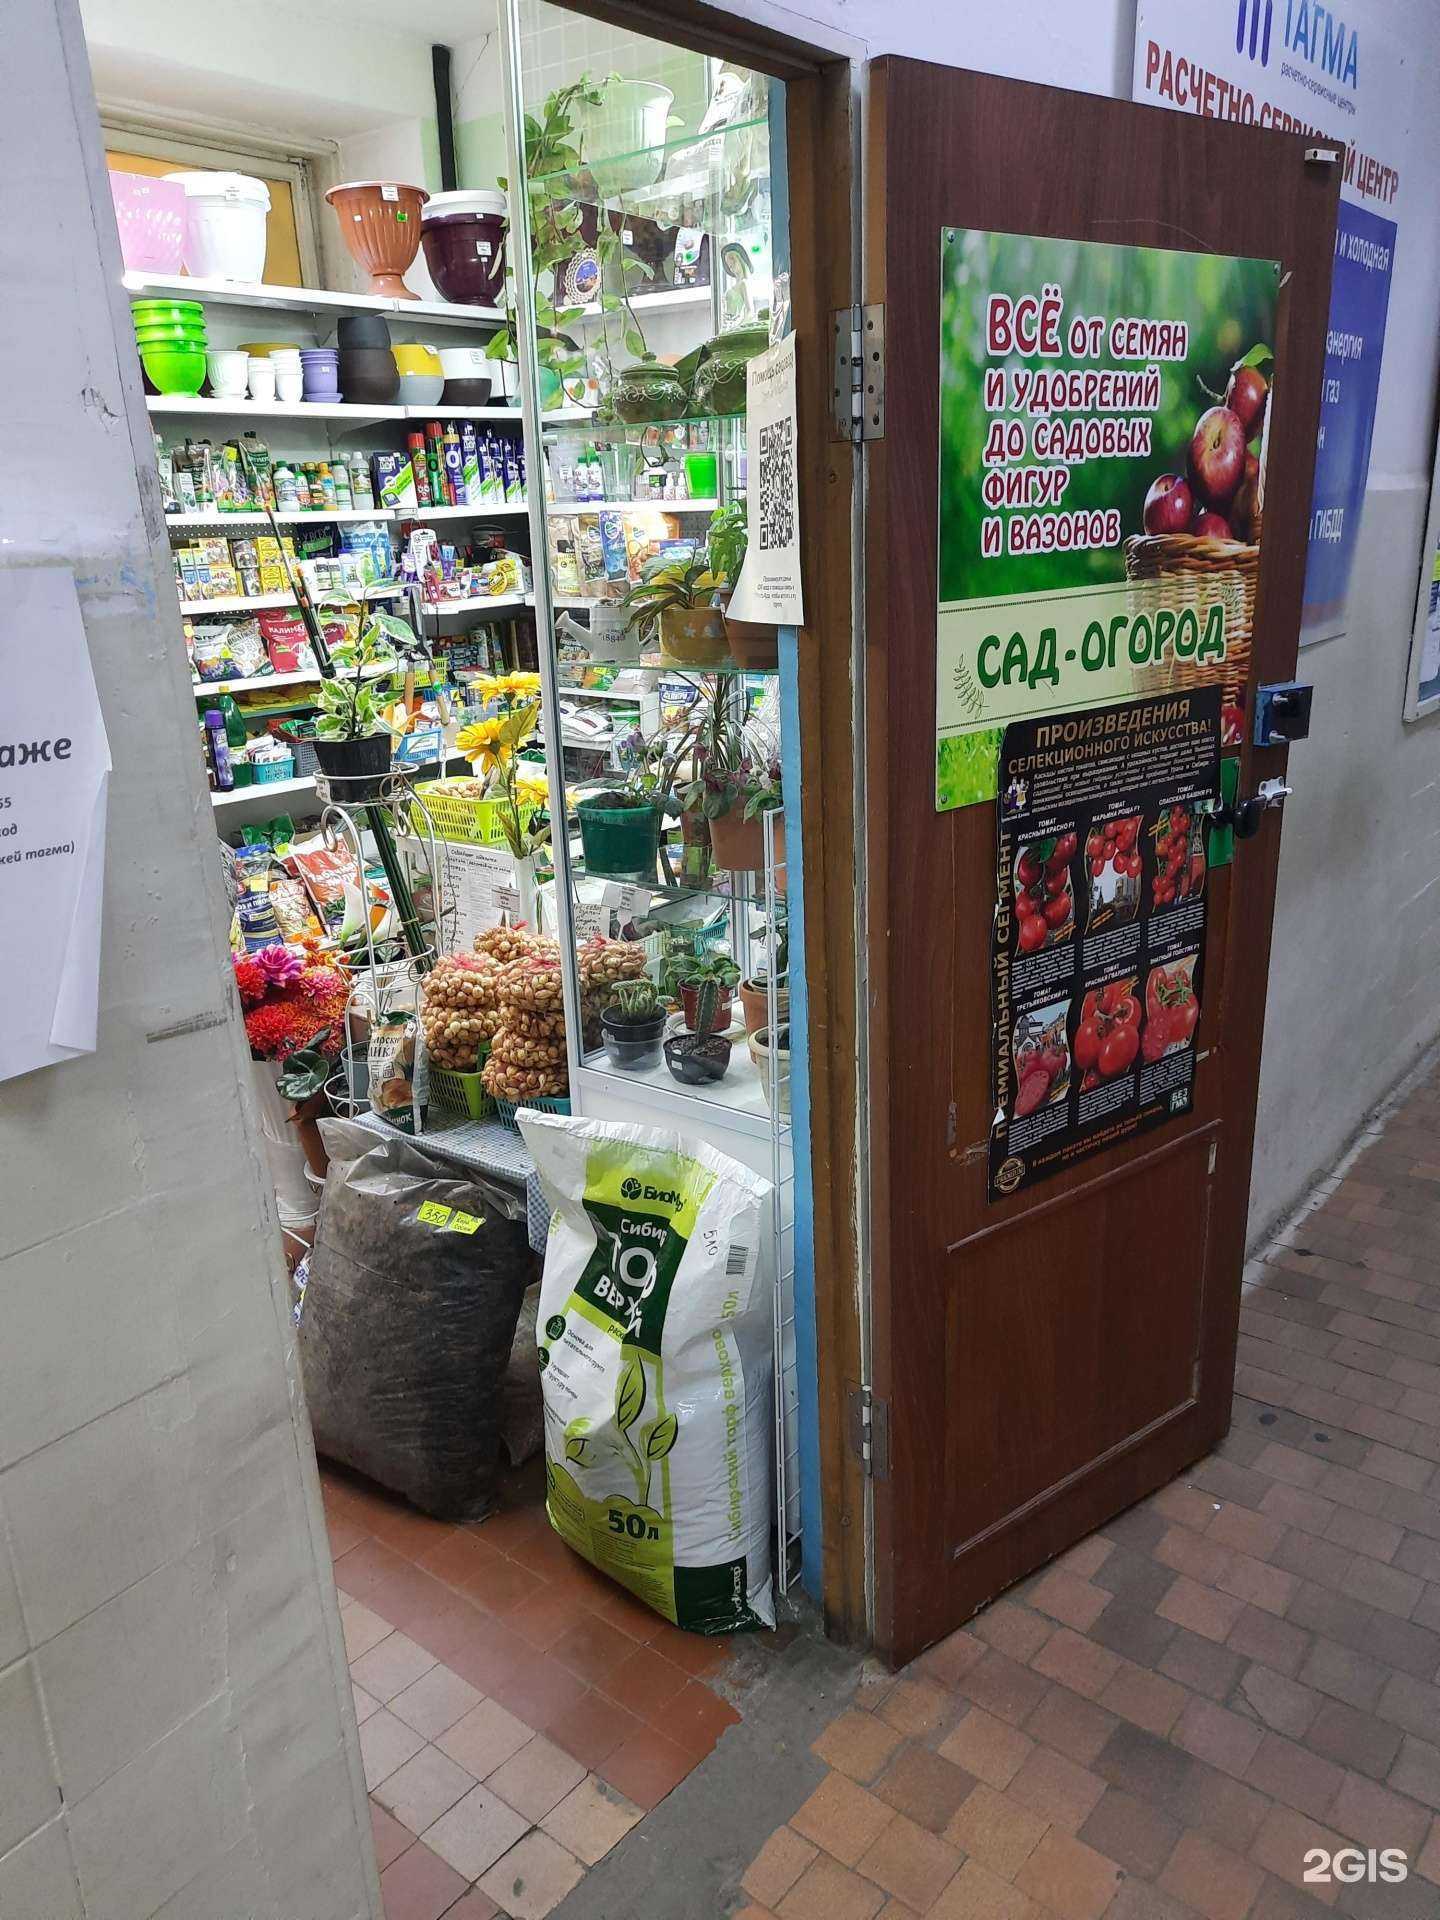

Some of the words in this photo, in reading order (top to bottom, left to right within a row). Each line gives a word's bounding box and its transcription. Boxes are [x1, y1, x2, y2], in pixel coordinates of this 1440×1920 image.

[1356, 153, 1399, 205] ЦЕНТР
[1347, 234, 1390, 273] холодная
[988, 285, 1065, 356] ВСЁ
[1110, 318, 1189, 361] СЕМЯН
[985, 371, 1006, 409] И
[1011, 368, 1161, 415] УДОБРЕНИЙ
[1325, 379, 1341, 404] газ
[983, 421, 1027, 465] ДО
[1033, 418, 1154, 463] САДОВЫХ
[983, 465, 1070, 508] ФИГУР
[982, 517, 1002, 555] И
[1007, 510, 1122, 554] ВАЗОНОВ
[1313, 508, 1344, 544] ГИБДД
[976, 605, 1226, 691] САД-ОГОРОД
[1036, 698, 1191, 749] ПРОИЗВЕДЕНИЯ
[1008, 737, 1130, 775] СЕЛЕКЦИОННОГО
[1133, 718, 1213, 748] ИСКУССТВА!
[1107, 799, 1127, 811] ТОМАТ
[1177, 783, 1195, 794] ТОМАТ
[1038, 817, 1057, 829] ТОМАТ
[25, 840, 75, 861] тагма)
[992, 955, 1010, 1141] ПЕМИАЛЬНЫЙ
